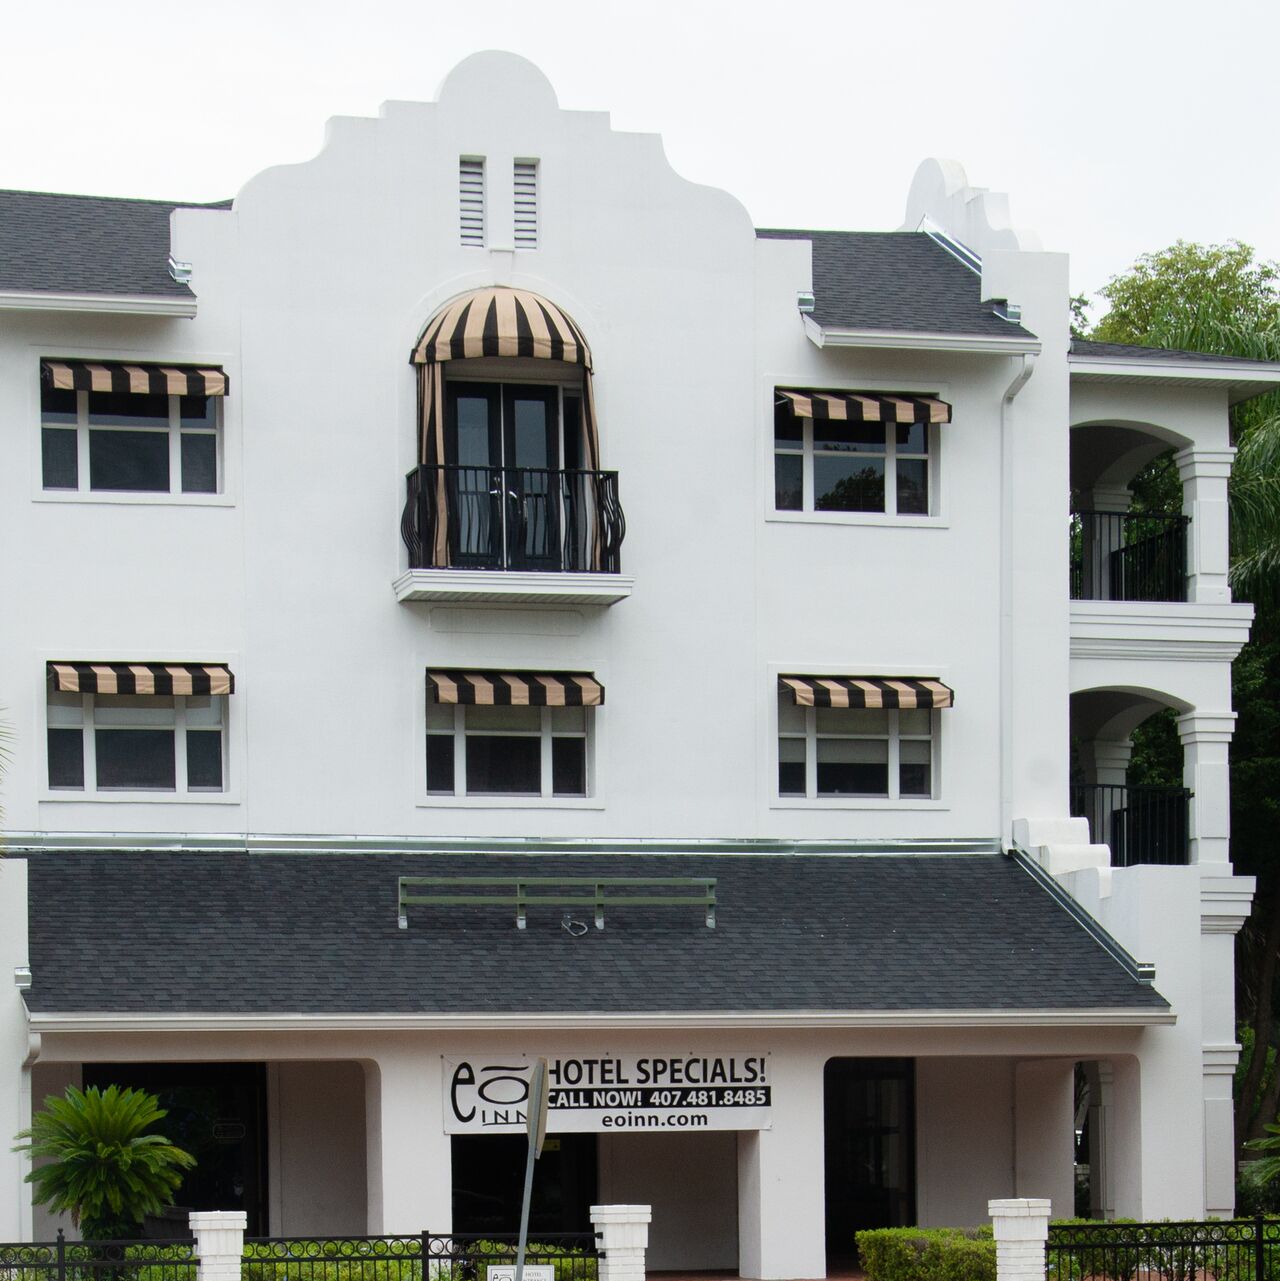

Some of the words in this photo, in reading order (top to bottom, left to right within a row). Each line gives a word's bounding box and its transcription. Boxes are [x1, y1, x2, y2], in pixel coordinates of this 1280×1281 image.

[548, 1058, 630, 1085] HOTEL
[636, 1057, 767, 1084] SPECIALS!
[547, 1092, 590, 1108] CALL
[593, 1091, 642, 1107] NOW!
[649, 1090, 767, 1106] 407.481.8485
[601, 1111, 709, 1128] eoinn.com
